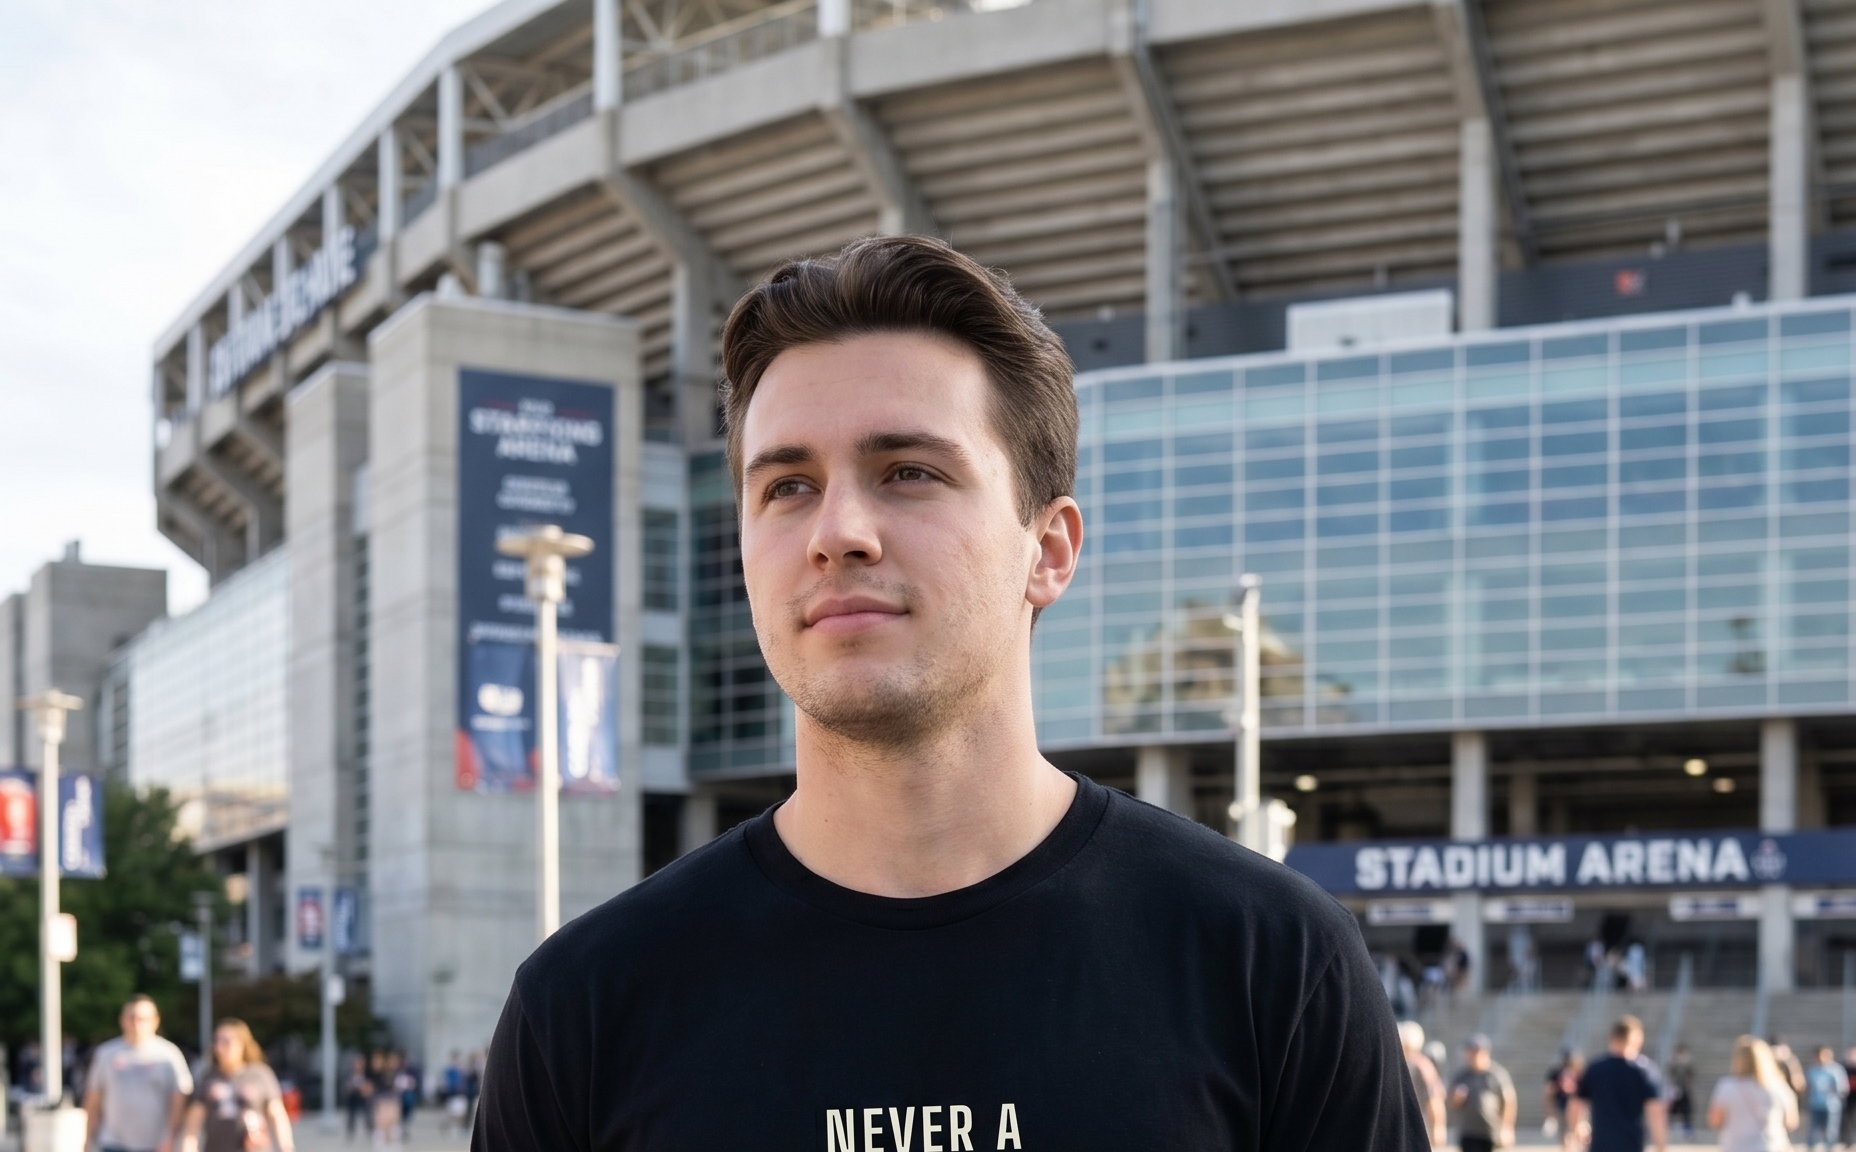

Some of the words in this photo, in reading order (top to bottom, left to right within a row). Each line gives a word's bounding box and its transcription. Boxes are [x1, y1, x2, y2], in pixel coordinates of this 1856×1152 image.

[1355, 844, 1566, 890] STADIUM
[1577, 837, 1749, 884] ARENA
[996, 1103, 1022, 1151] A
